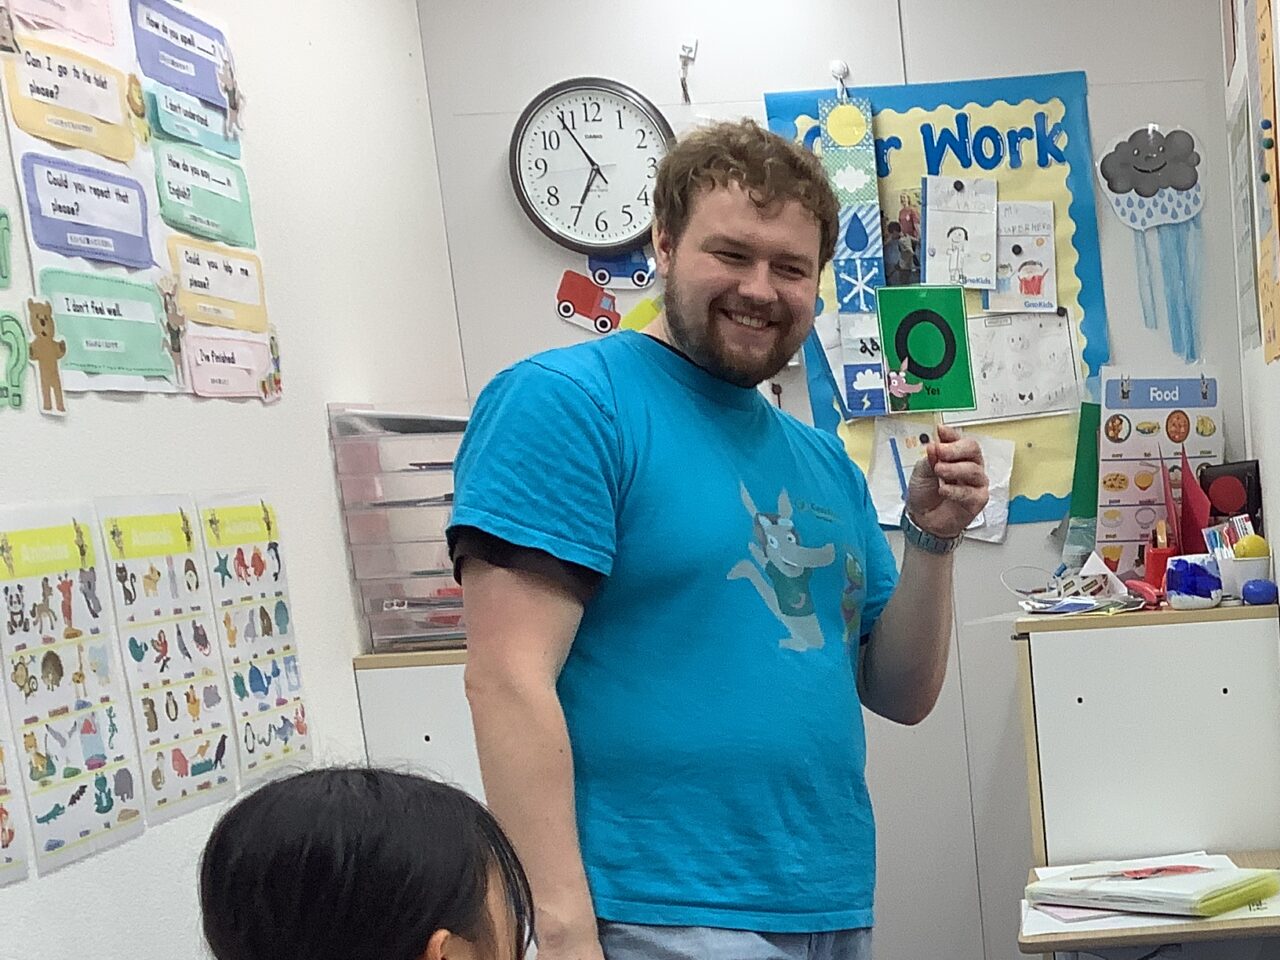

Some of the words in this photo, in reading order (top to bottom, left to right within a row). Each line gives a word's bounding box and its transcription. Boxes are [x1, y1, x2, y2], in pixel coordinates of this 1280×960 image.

[25, 51, 41, 68] Can
[46, 56, 52, 71] I
[58, 65, 68, 78] go
[29, 79, 59, 99] please?
[559, 110, 577, 130] 11
[582, 102, 602, 122] 12
[615, 110, 624, 129] 1
[541, 130, 560, 150] 10
[635, 129, 647, 149] 2
[920, 112, 1067, 176] Work
[167, 153, 180, 169] How
[535, 158, 548, 179] 9
[647, 157, 659, 178] 3
[47, 170, 68, 188] Could
[73, 182, 86, 194] you
[89, 185, 111, 199] repeat
[115, 188, 129, 204] that
[547, 186, 560, 206] 8
[637, 185, 650, 206] 4
[51, 198, 79, 216] please?
[570, 205, 582, 226] 7
[621, 205, 633, 226] 5
[595, 210, 608, 232] 6
[185, 251, 200, 266] Could
[207, 260, 218, 270] you
[240, 267, 249, 277] me
[189, 276, 210, 289] please?
[65, 297, 71, 312] I
[72, 298, 89, 313] don't
[91, 301, 105, 315] feel
[1150, 386, 1179, 401] Food
